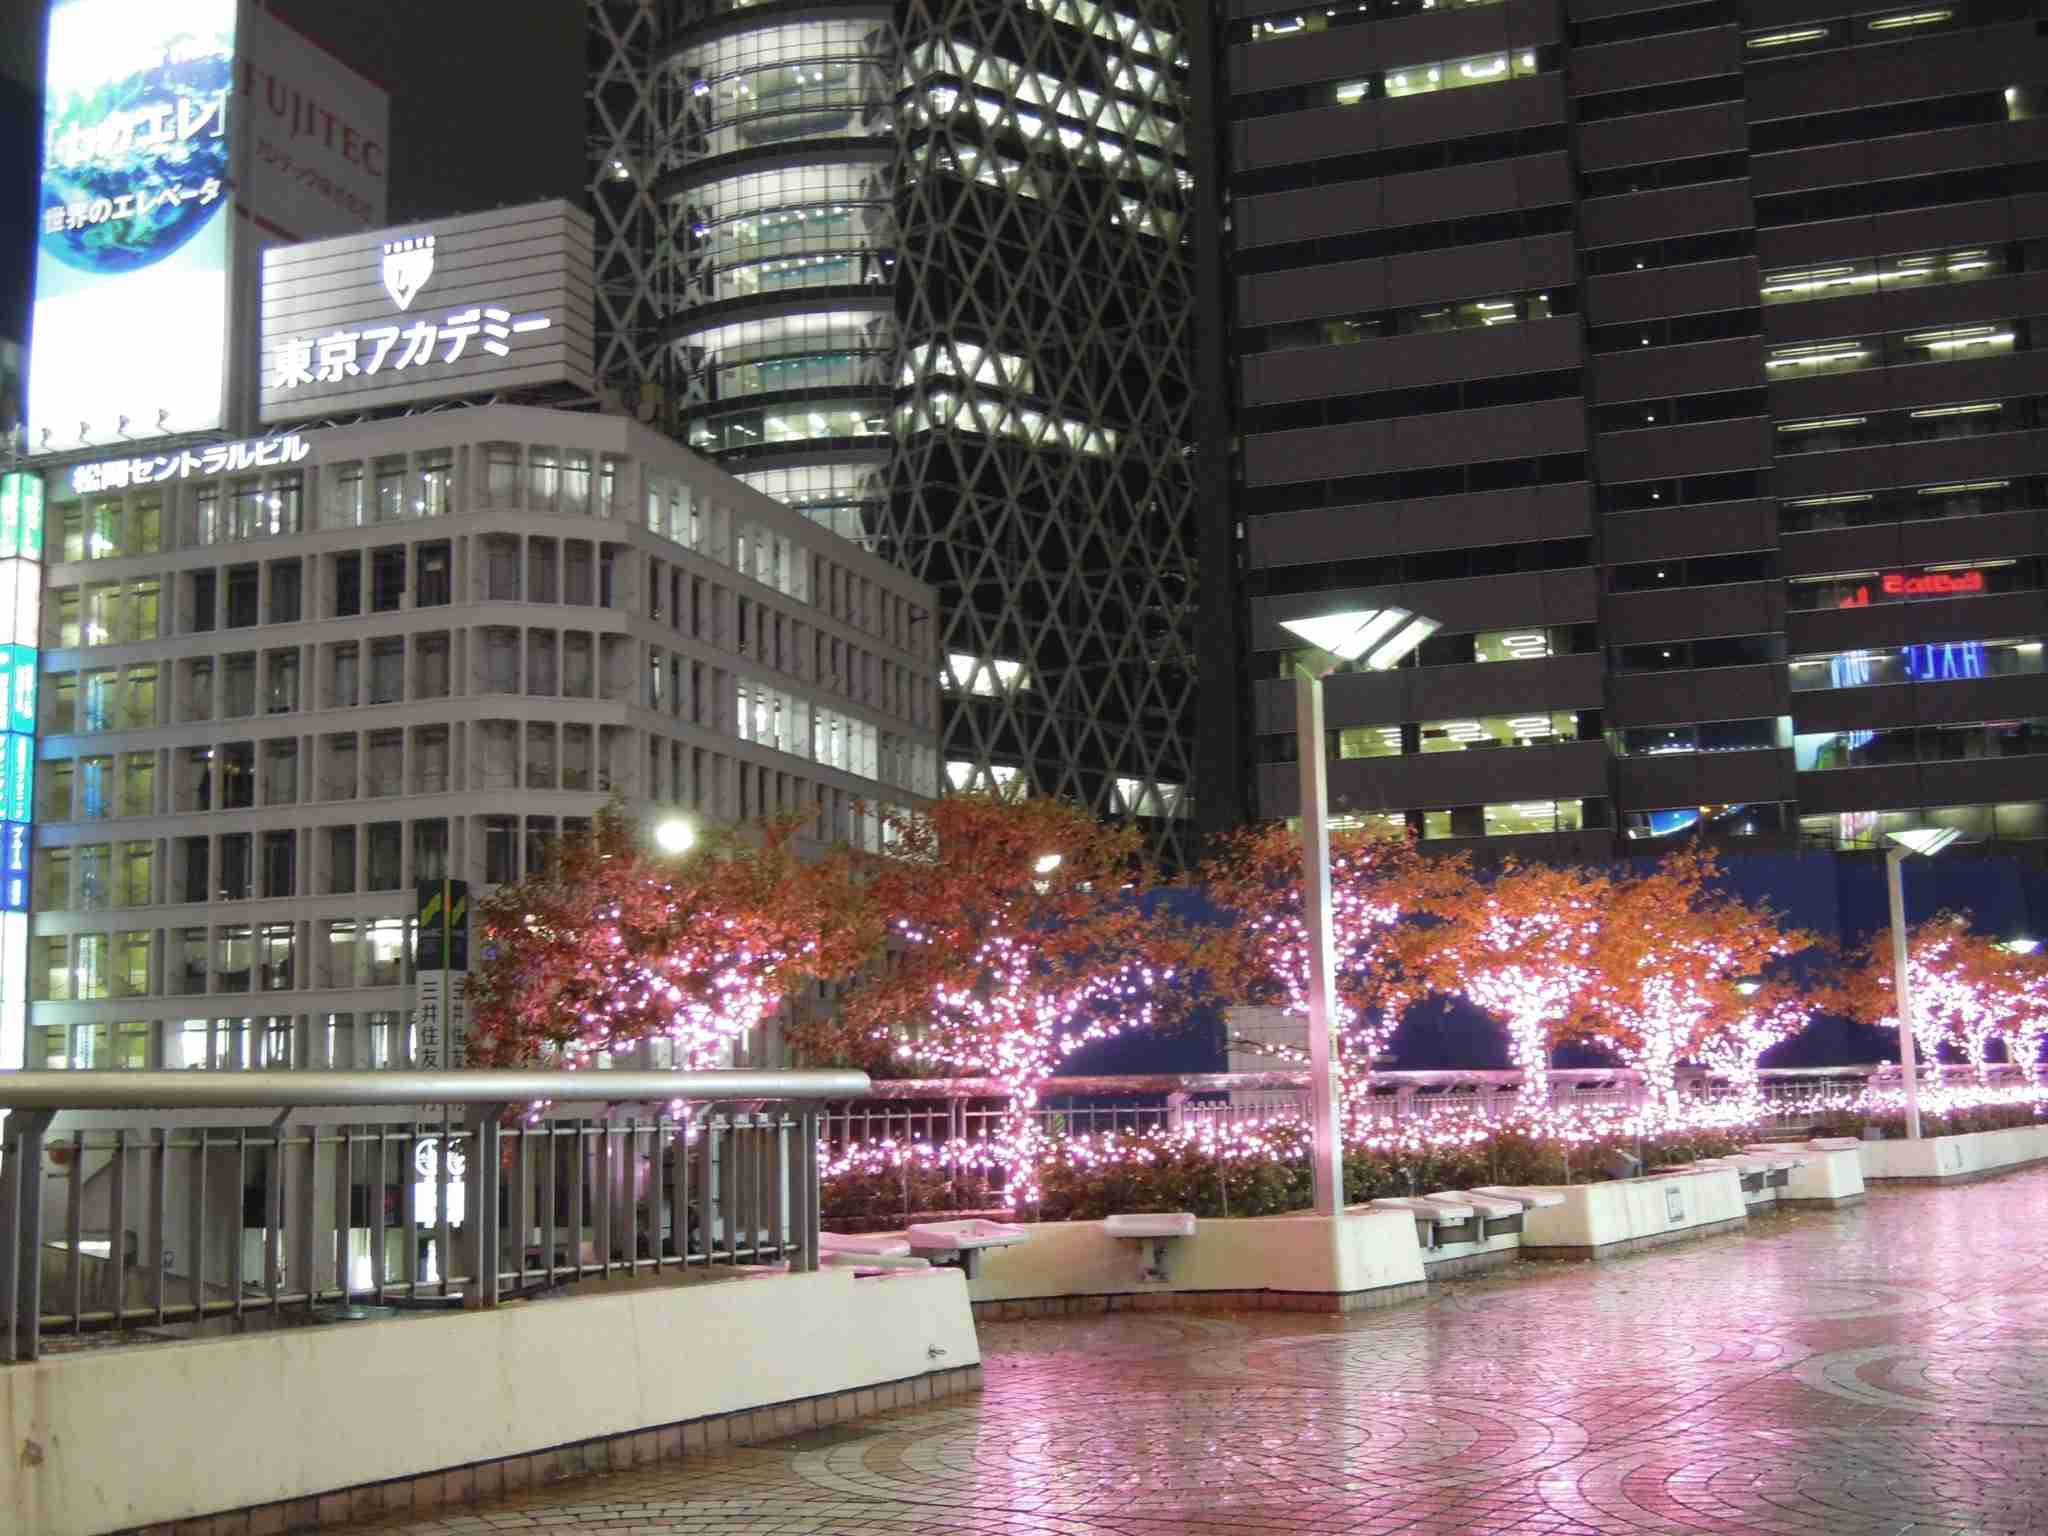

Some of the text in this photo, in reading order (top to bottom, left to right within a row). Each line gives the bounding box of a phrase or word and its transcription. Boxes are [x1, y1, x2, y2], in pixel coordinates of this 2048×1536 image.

[243, 60, 384, 177] FUJITEC
[272, 308, 551, 389] 東京アカデミー
